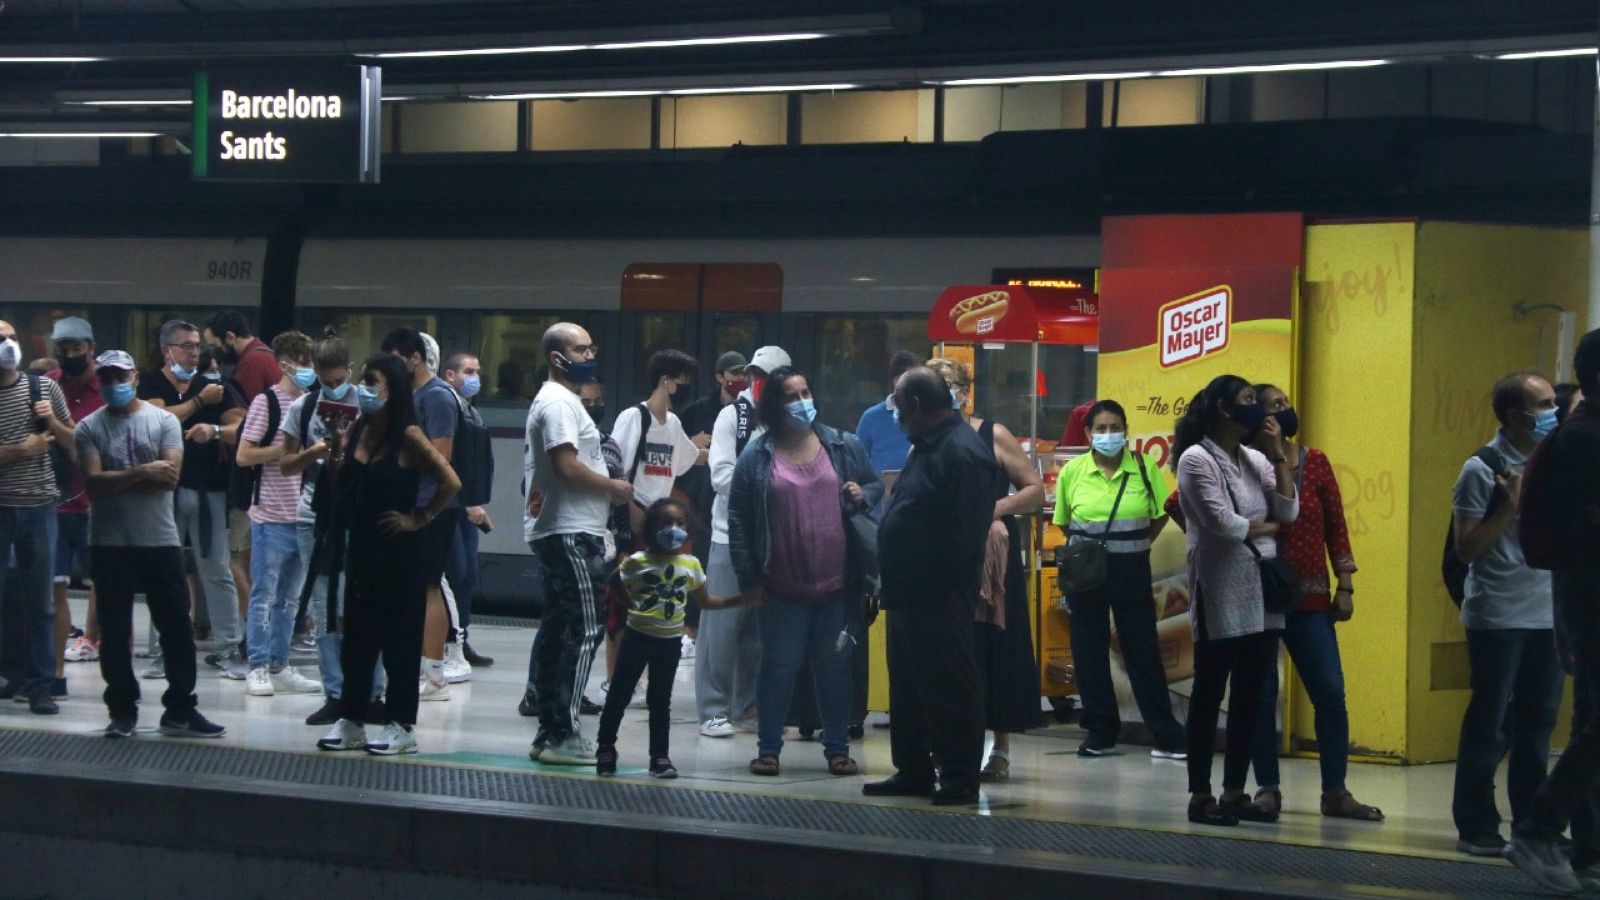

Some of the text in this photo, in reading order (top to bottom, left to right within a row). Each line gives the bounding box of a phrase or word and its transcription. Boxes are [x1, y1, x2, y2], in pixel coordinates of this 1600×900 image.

[221, 88, 342, 119] Barcelona
[219, 130, 287, 160] Sants
[207, 260, 252, 280] 940R
[1075, 298, 1097, 315] The
[1170, 301, 1221, 333] Oscar
[1167, 321, 1224, 355] Mayer
[1147, 395, 1170, 416] The
[738, 403, 747, 439] PARIS
